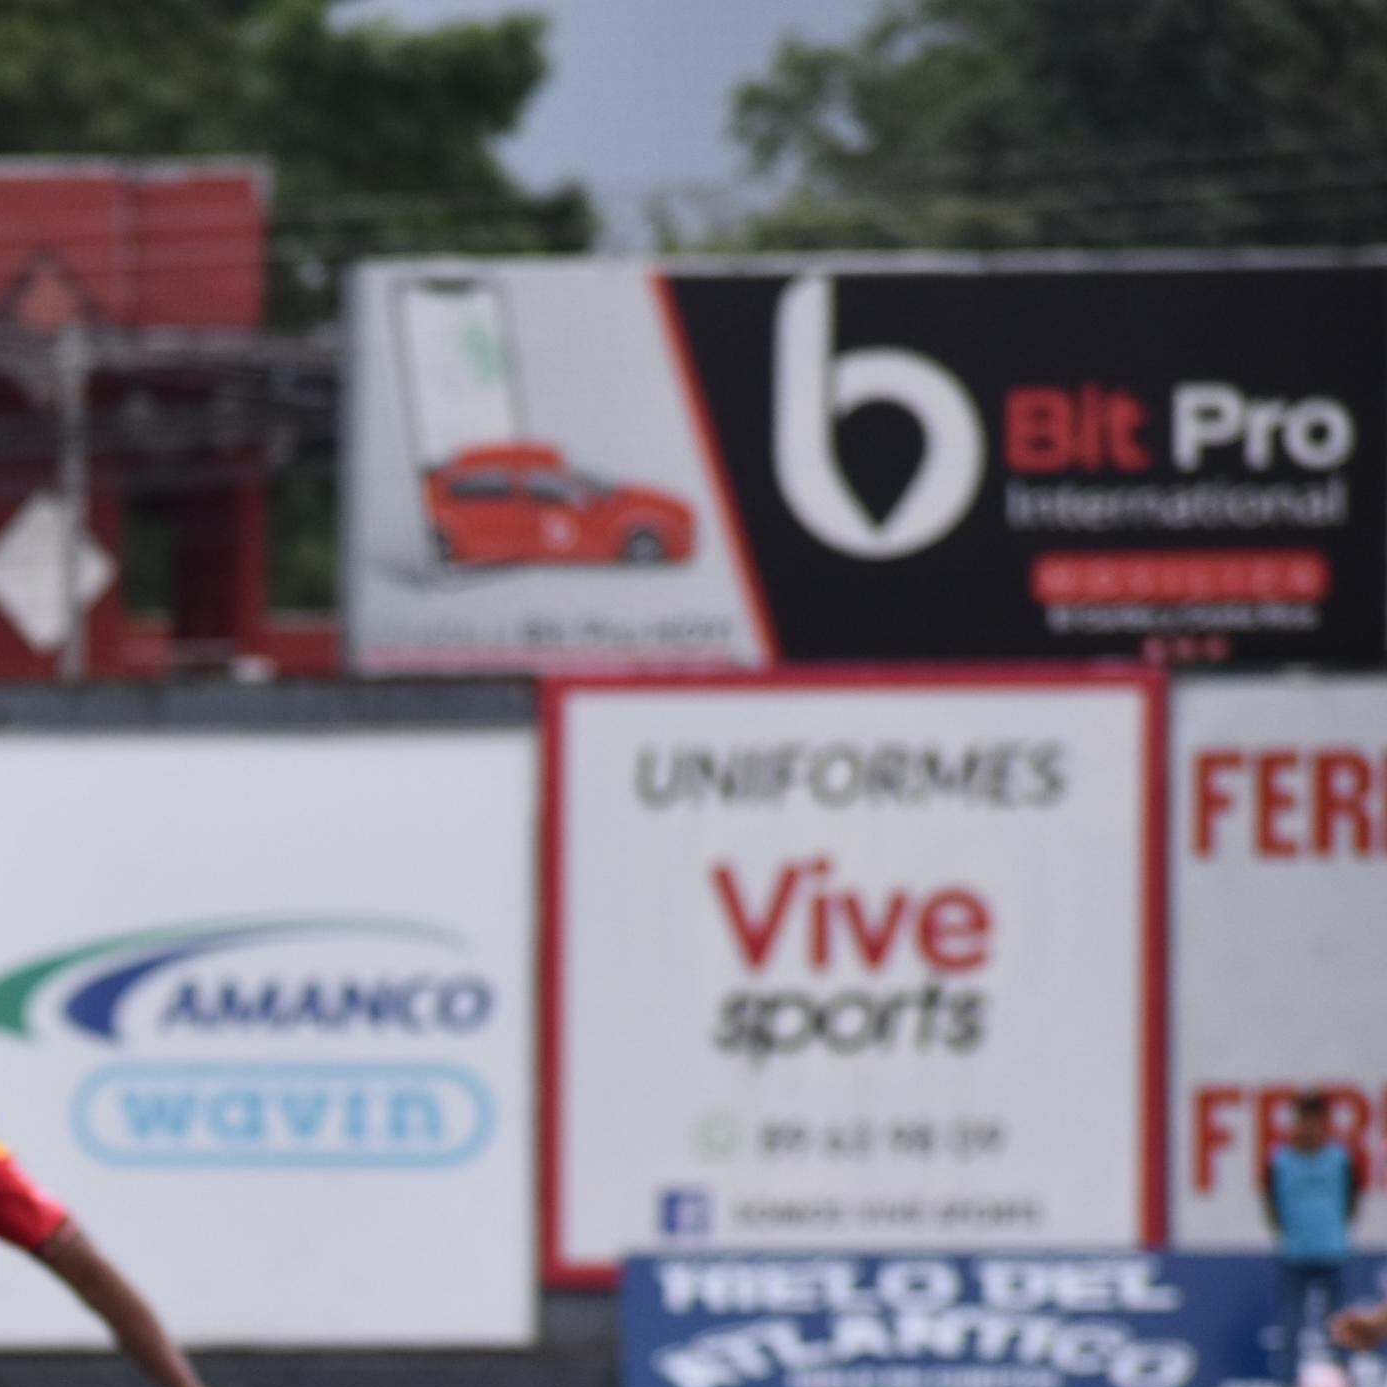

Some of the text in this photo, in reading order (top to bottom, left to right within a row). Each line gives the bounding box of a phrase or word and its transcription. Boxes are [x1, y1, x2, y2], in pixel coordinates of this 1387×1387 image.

[1004, 381, 1358, 474] Bit Pro
[1004, 478, 1349, 530] International
[638, 740, 1069, 812] UNIFORMES
[1190, 748, 1387, 862] FER
[711, 853, 994, 974] Vive
[161, 975, 496, 1036] AMANCO
[713, 980, 987, 1070] sports
[119, 1087, 448, 1142] wavin
[655, 1257, 1187, 1316] HIELO DEL
